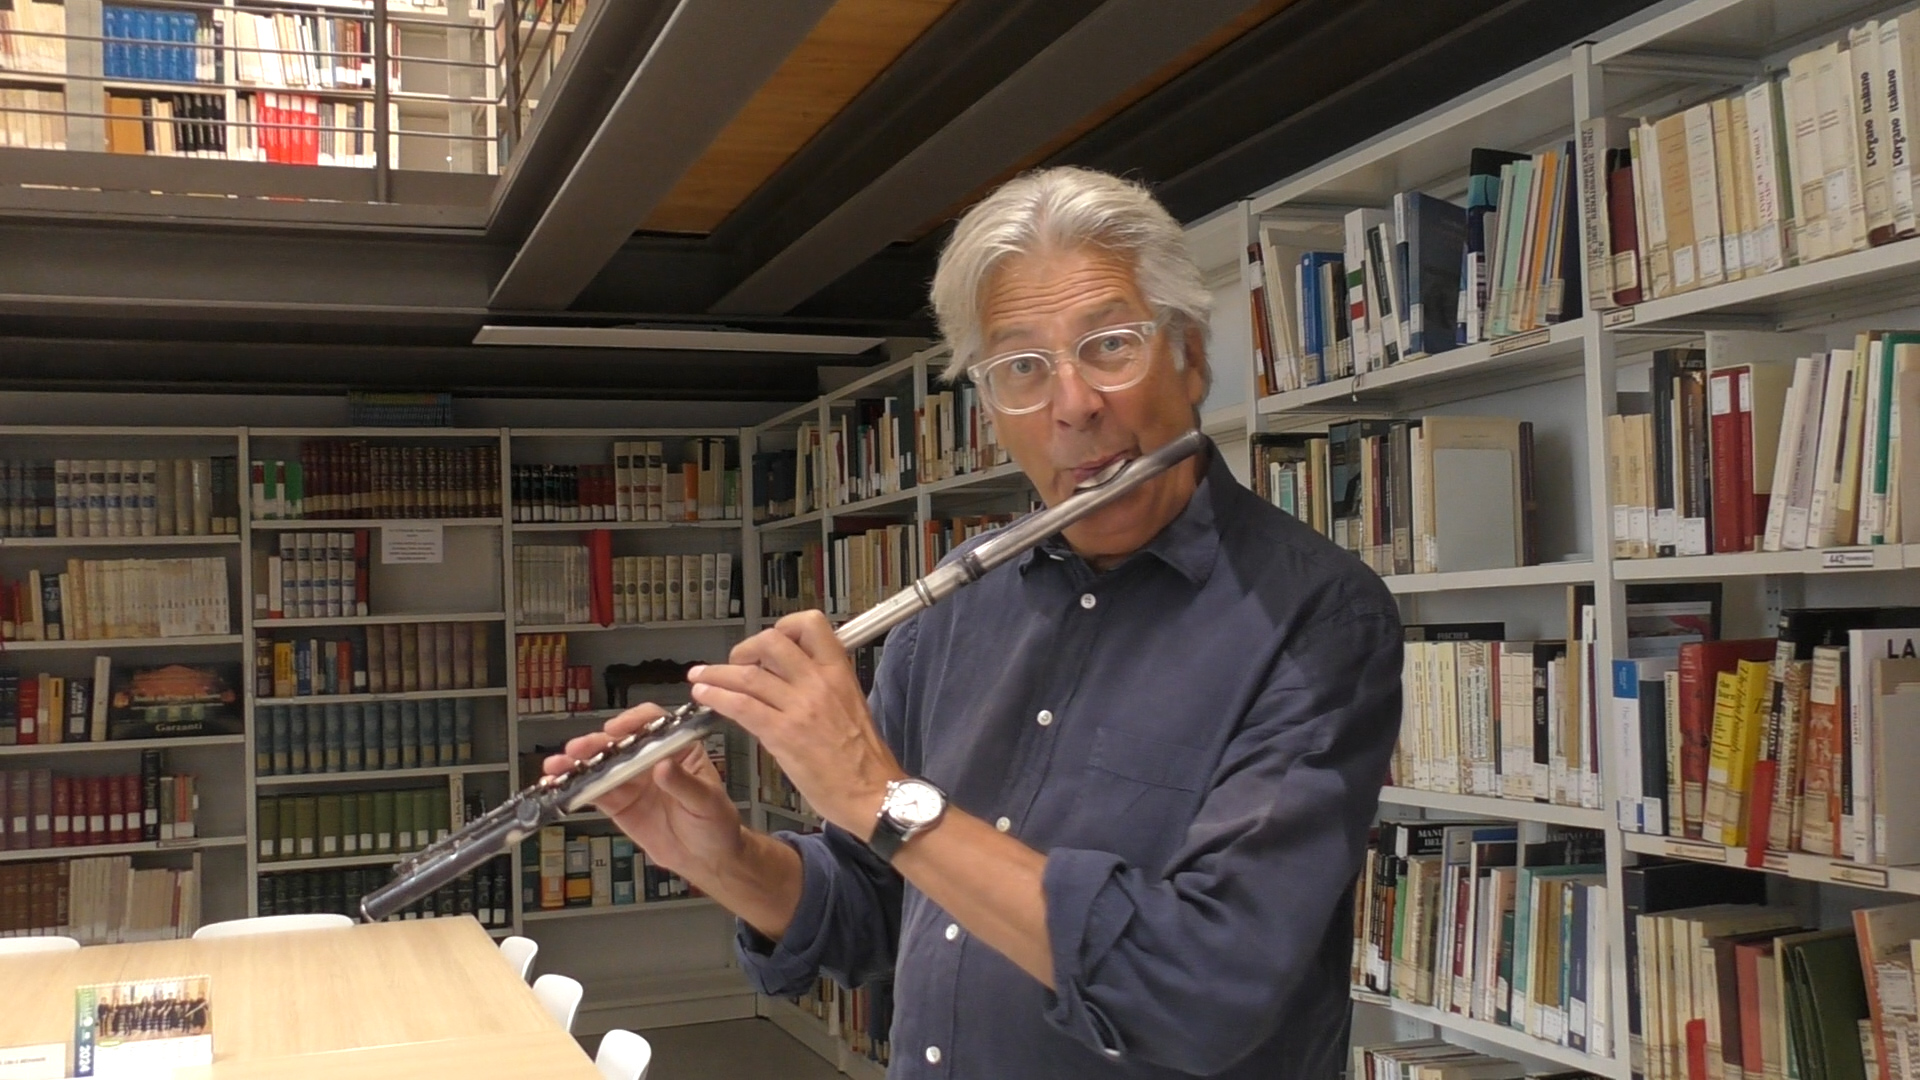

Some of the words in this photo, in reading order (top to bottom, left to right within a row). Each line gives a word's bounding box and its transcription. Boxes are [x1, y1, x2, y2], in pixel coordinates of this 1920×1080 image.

[1860, 71, 1872, 115] Italiano
[1887, 69, 1899, 113] Italiano
[1864, 119, 1878, 168] L'Organo
[1891, 118, 1906, 168] L'Organo
[1887, 639, 1917, 659] LA
[155, 722, 203, 732] Garzanti
[78, 1045, 91, 1073] 2024
